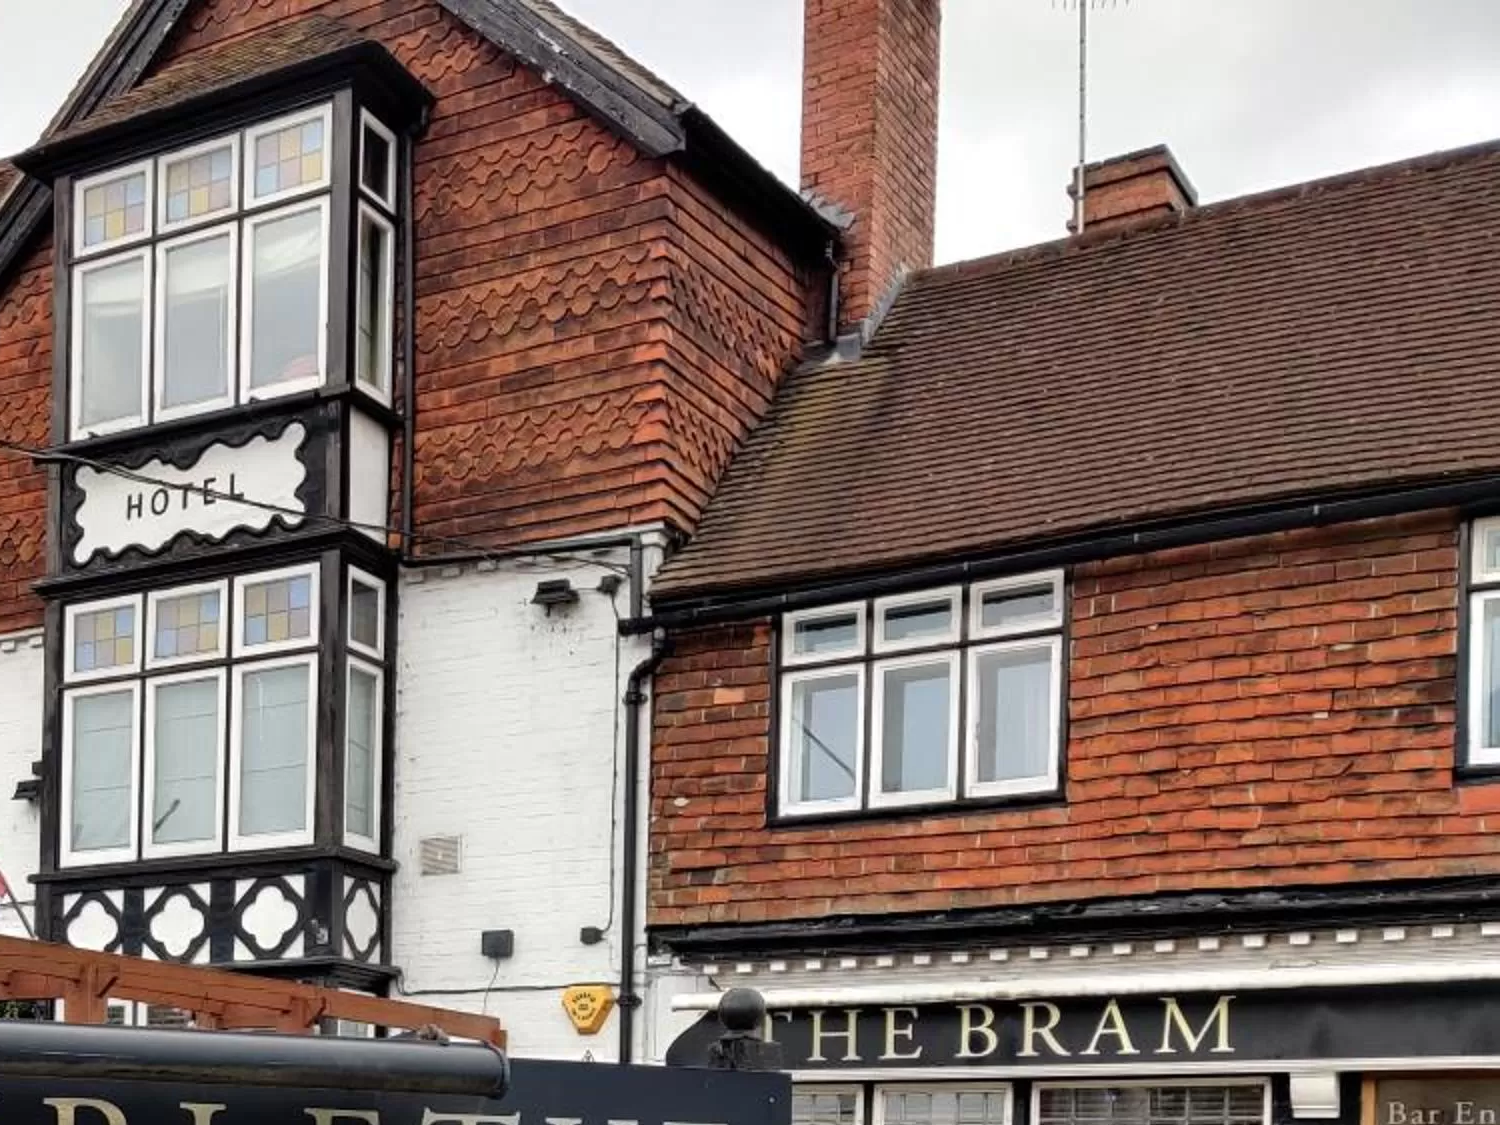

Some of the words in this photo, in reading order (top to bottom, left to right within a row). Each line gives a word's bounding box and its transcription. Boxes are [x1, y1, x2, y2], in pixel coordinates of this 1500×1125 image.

[126, 472, 245, 521] HOTEL
[954, 994, 1238, 1060] BRAM
[1386, 1100, 1441, 1125] Bar
